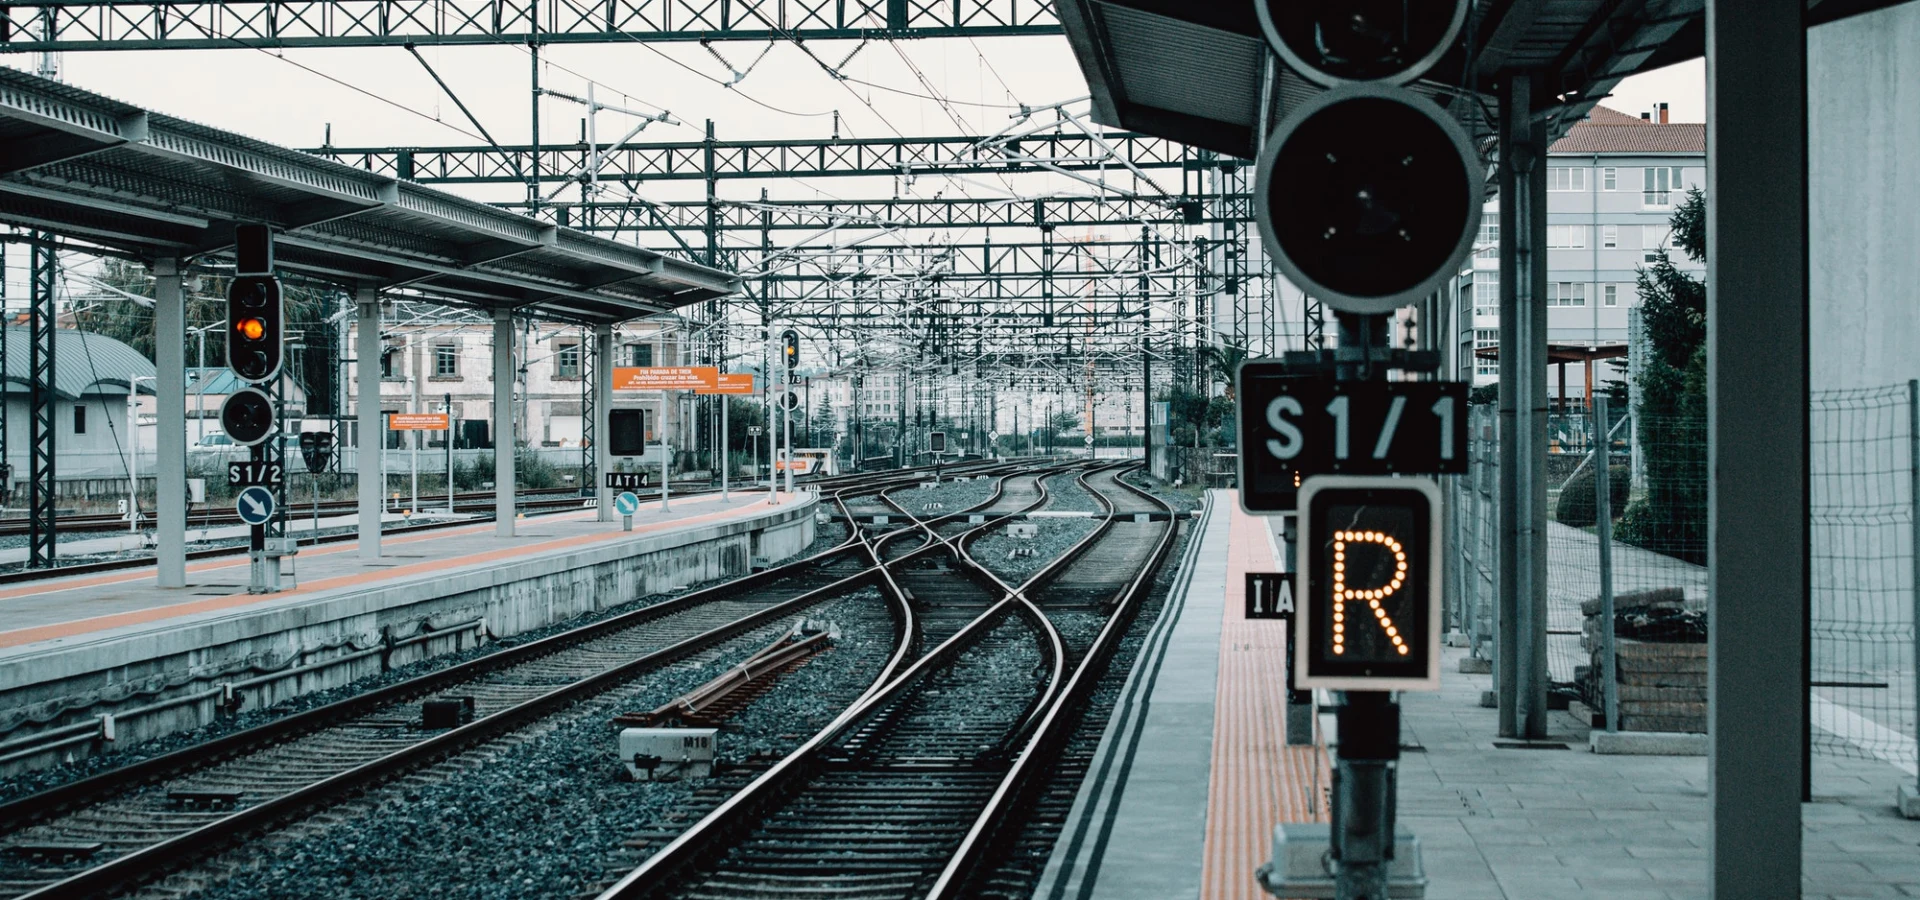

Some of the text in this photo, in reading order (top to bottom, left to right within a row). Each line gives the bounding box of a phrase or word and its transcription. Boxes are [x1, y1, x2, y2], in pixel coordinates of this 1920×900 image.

[1266, 396, 1454, 459] S1/1
[230, 465, 281, 483] S1/2
[608, 475, 648, 487] IAT14
[1333, 530, 1408, 655] R
[683, 736, 708, 748] M18
